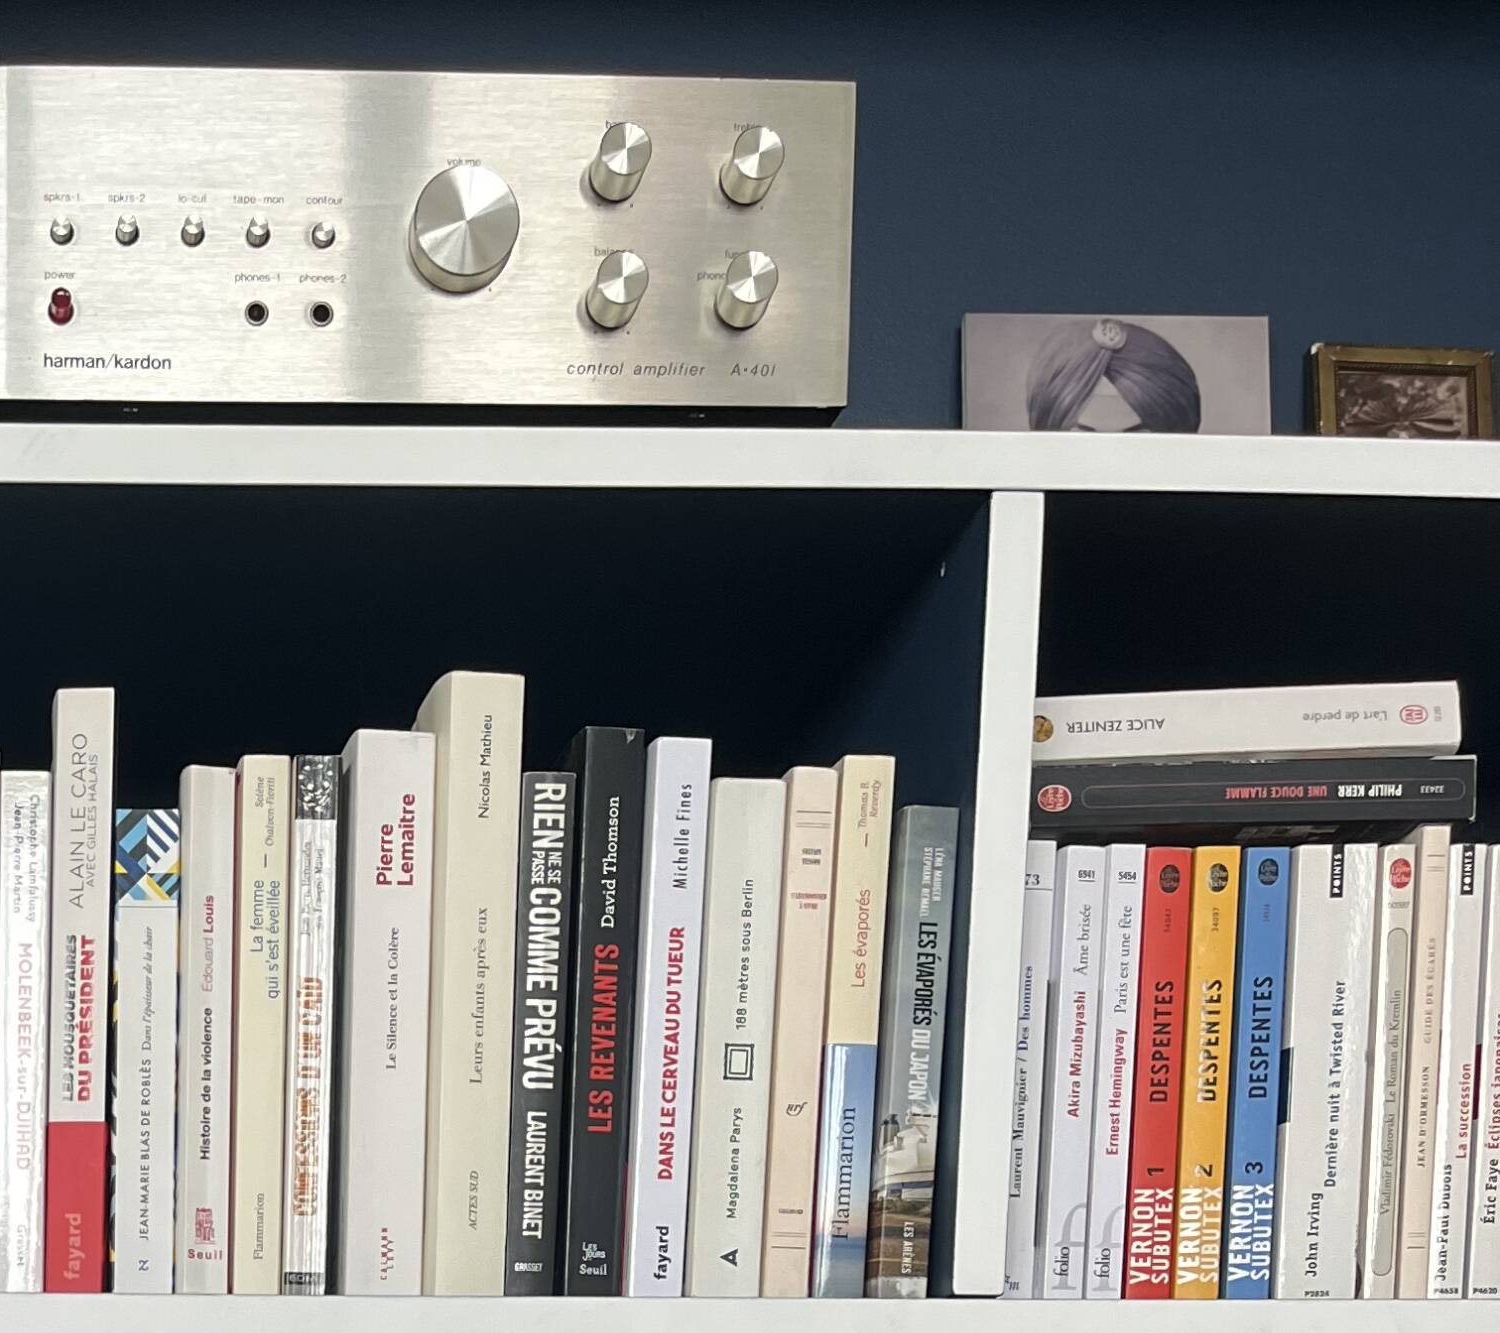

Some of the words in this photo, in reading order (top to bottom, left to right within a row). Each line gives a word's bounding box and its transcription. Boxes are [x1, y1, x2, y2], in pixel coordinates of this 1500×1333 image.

[305, 196, 344, 206] contour
[43, 271, 77, 282] power
[234, 273, 282, 285] phones-1
[298, 273, 348, 285] phones-2
[43, 353, 173, 371] harman/kardon
[566, 362, 625, 377] control
[633, 362, 706, 379] amplifier
[479, 713, 494, 767] Mathieu
[1065, 719, 1124, 736] ZENITER
[1128, 717, 1165, 733] ALICE
[71, 733, 88, 798] CARO
[1367, 783, 1403, 797] PHILIP
[477, 770, 491, 819] Nicolas
[532, 782, 567, 849] RIEN
[675, 783, 693, 822] Fines
[1224, 786, 1268, 801] FLAMME
[1337, 784, 1365, 799] KERR
[71, 806, 86, 832] LE
[86, 805, 97, 849] GILLES
[396, 793, 416, 887] Lemaitre
[602, 796, 621, 875] Thomson
[68, 838, 86, 909] ALAIN
[86, 853, 96, 888] AVEC
[375, 823, 395, 887] Pierre
[672, 827, 691, 889] Michelle
[1332, 852, 1343, 895] POINTS
[1462, 850, 1474, 892] POINTS
[203, 895, 215, 934] Louis
[249, 880, 264, 930] femme
[267, 880, 281, 934] éveillée
[600, 879, 616, 928] David
[741, 879, 754, 918] Berlin
[856, 888, 872, 957] évaporés
[1076, 904, 1092, 940] brisée
[266, 934, 279, 972] s'est
[387, 926, 400, 971] Colère
[525, 887, 563, 992] COMME
[666, 926, 686, 988] TUEUR
[741, 922, 753, 953] sous
[917, 921, 939, 949] LES
[75, 934, 96, 1064] PRÉSIDENT
[736, 956, 750, 999] mètres
[850, 961, 865, 988] Les
[913, 949, 942, 1027] ÉVAPORÉS
[1018, 965, 1034, 1020] hommes
[1113, 980, 1128, 1014] Paris
[1331, 980, 1347, 1017] River
[62, 934, 78, 1069] MOUSQUETAIRES
[470, 983, 486, 1038] enfants
[589, 943, 620, 1081] REVENANTS
[665, 989, 682, 1016] DU
[735, 1007, 748, 1031] 188
[1388, 990, 1403, 1032] Kremlin
[202, 1007, 213, 1066] violence
[386, 1003, 398, 1052] Silence
[522, 1000, 562, 1091] PRÉVU
[1017, 1027, 1029, 1052] Des
[1069, 991, 1087, 1076] Mizubayashi
[1149, 980, 1174, 1103] DESPENTES
[1196, 979, 1222, 1103] DESPENTES
[1247, 975, 1274, 1098] DESPENTES
[1328, 1022, 1344, 1074] Twisted
[15, 943, 34, 1170] MOLENBEEK-sur-DJIHAD
[138, 1058, 152, 1105] ROBLÈS
[469, 1038, 484, 1084] Leurs
[661, 1017, 681, 1105] CERVEAU
[907, 1050, 930, 1102] JAPON
[1108, 1028, 1129, 1109] Hemingway
[77, 1067, 91, 1103] DU
[1012, 1068, 1030, 1141] Mauvignier
[1067, 1079, 1082, 1118] Akira
[1329, 1096, 1341, 1124] nuit
[1458, 1062, 1472, 1141] succession
[200, 1106, 212, 1160] Histoire
[587, 1089, 614, 1133] LES
[728, 1107, 742, 1144] Parys
[1106, 1110, 1121, 1156] Ernest
[140, 1125, 151, 1160] BLAS
[523, 1111, 548, 1188] LAURENT
[657, 1131, 675, 1181] DANS
[1323, 1126, 1340, 1188] Dernière
[726, 1148, 741, 1219] Magdalena
[831, 1106, 857, 1241] Flammarion
[1009, 1142, 1024, 1199] Laurent
[1441, 1164, 1453, 1210] Dubois
[138, 1164, 150, 1241] JEAN-MARIE
[253, 1192, 265, 1260] Flammarion
[521, 1189, 544, 1240] BINET
[1308, 1192, 1324, 1239] Irving
[63, 1212, 82, 1281] fayard
[187, 1248, 224, 1261] Seuil
[653, 1225, 670, 1281] fayard
[1129, 1188, 1156, 1285] VERNON
[1150, 1186, 1175, 1284] SUBUTEX
[1176, 1187, 1203, 1285] VERNON
[1199, 1186, 1222, 1283] SUBUTEX
[1227, 1184, 1255, 1282] VERNON
[1250, 1183, 1274, 1281] SUBUTEX
[1434, 1212, 1450, 1282] Jean-Paul
[579, 1263, 608, 1276] Seuil
[1304, 1243, 1319, 1278] John
